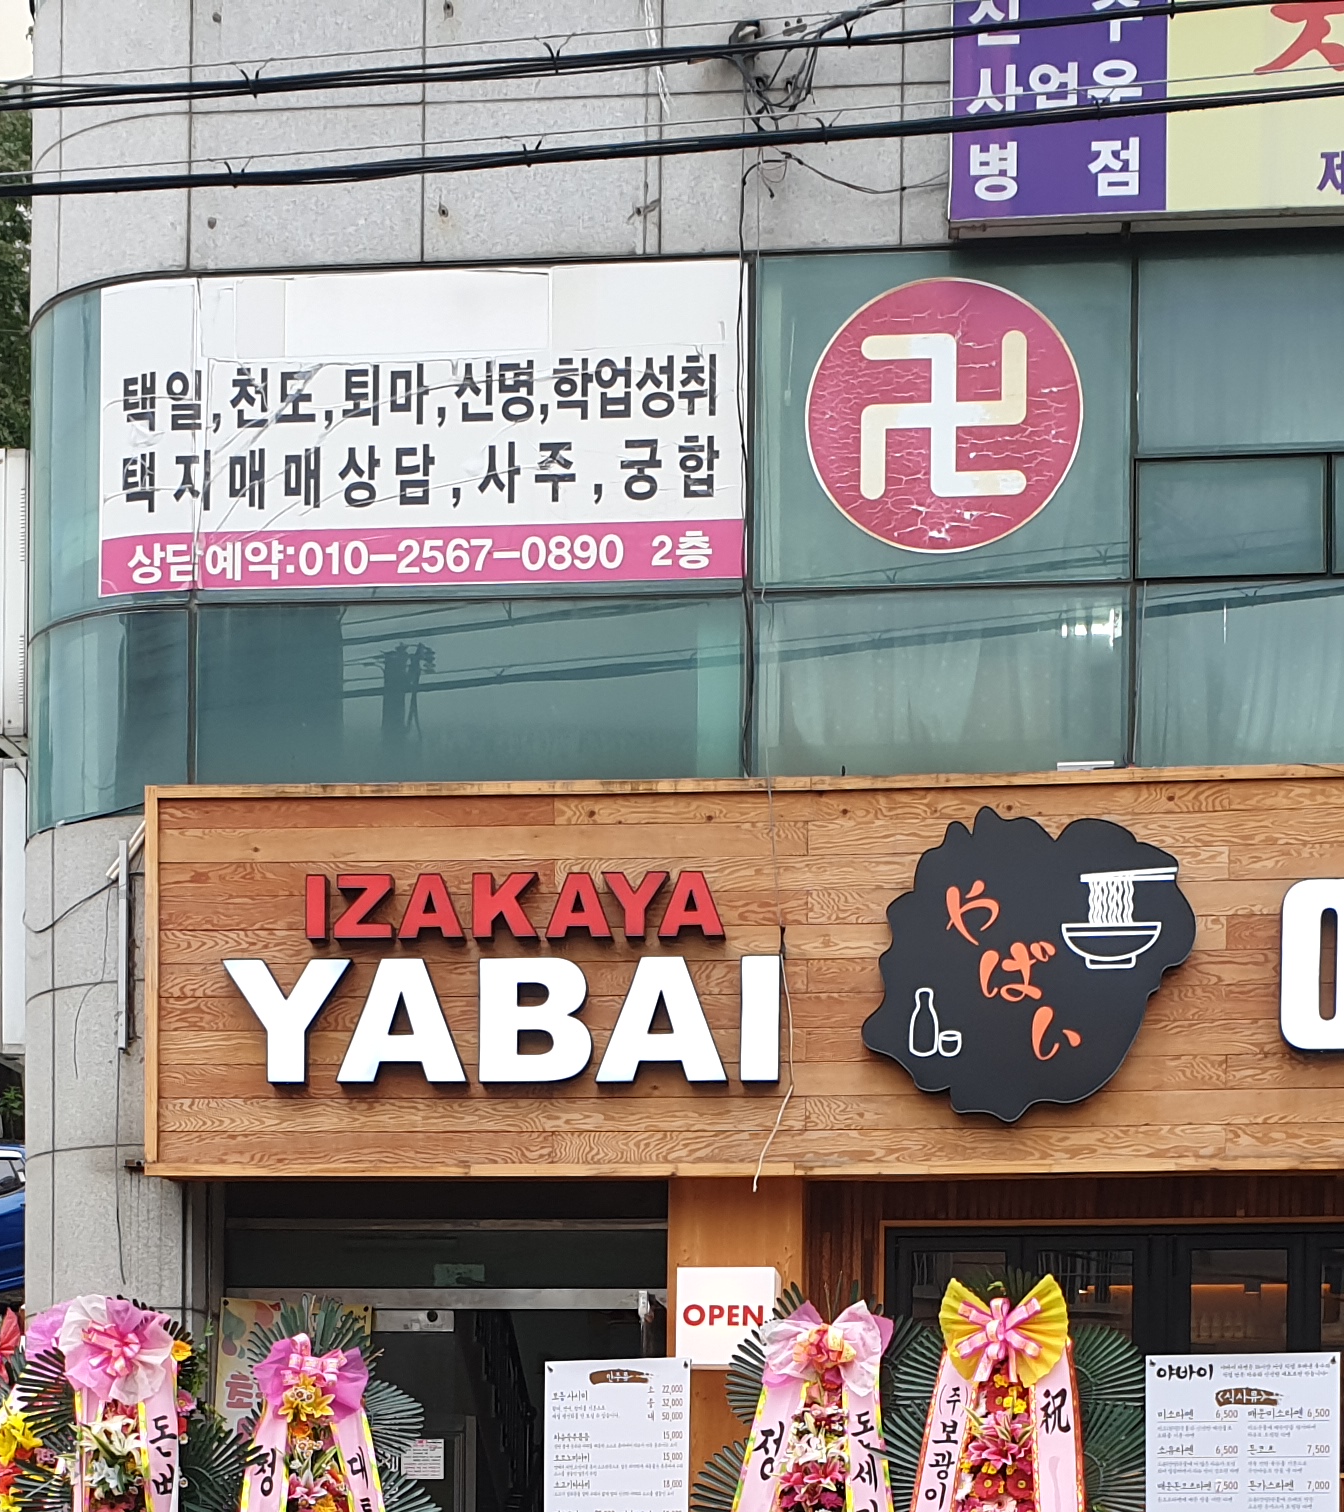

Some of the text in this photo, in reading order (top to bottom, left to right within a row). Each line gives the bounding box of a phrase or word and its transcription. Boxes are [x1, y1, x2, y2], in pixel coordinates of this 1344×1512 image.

[620, 434, 720, 499] 궁합
[650, 529, 714, 571] 2층
[301, 869, 728, 942] IZAKAYA
[219, 951, 785, 1085] YABAI
[682, 1303, 764, 1327] OPEN
[1156, 1363, 1214, 1381] 야바이
[1215, 1408, 1239, 1421] 6,500
[1307, 1408, 1331, 1420] 6,500
[1215, 1444, 1239, 1457] 6,500
[1307, 1444, 1331, 1457] 7,500
[1307, 1480, 1331, 1493] 7,000
